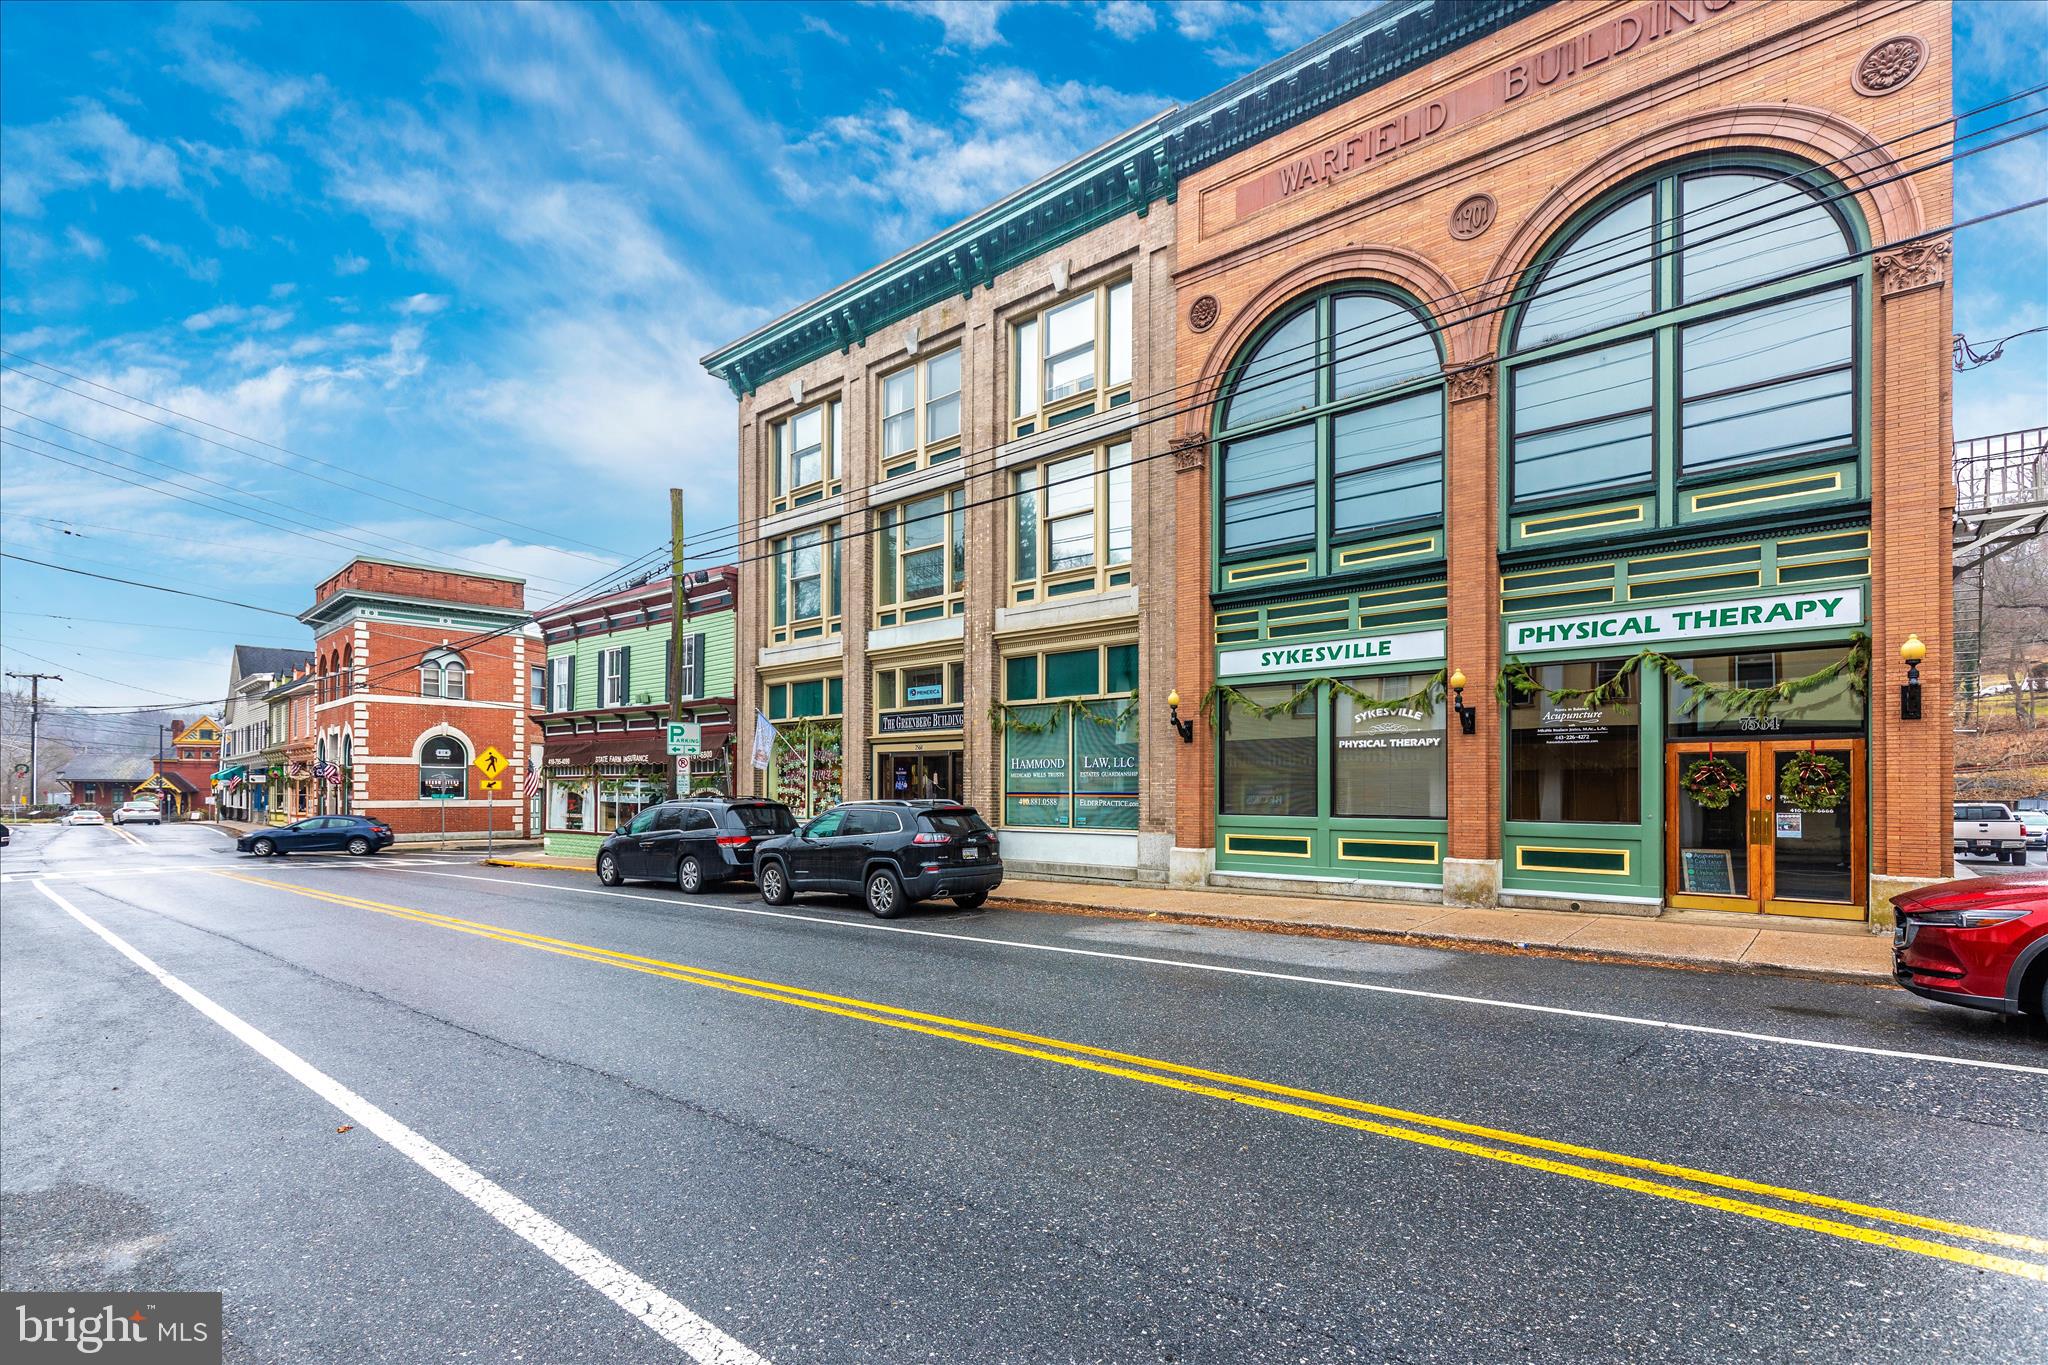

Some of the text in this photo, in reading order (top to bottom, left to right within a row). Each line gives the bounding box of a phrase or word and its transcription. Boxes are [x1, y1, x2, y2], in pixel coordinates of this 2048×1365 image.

[1279, 101, 1448, 195] WARFIELD
[1455, 202, 1490, 234] 1901
[1518, 597, 1844, 645] PHYSICAL THERAPY
[1260, 640, 1392, 667] SYKESVILLE
[1354, 707, 1424, 723] SYKESVILLE
[1542, 711, 1603, 722] Acupuncture
[670, 725, 699, 744] PARKING
[1338, 737, 1441, 749] PHYSICAL THERAPY
[609, 755, 622, 763] FARM
[623, 754, 649, 763] INSURANCE
[1011, 756, 1135, 769] HAMMOND LAW, LLC
